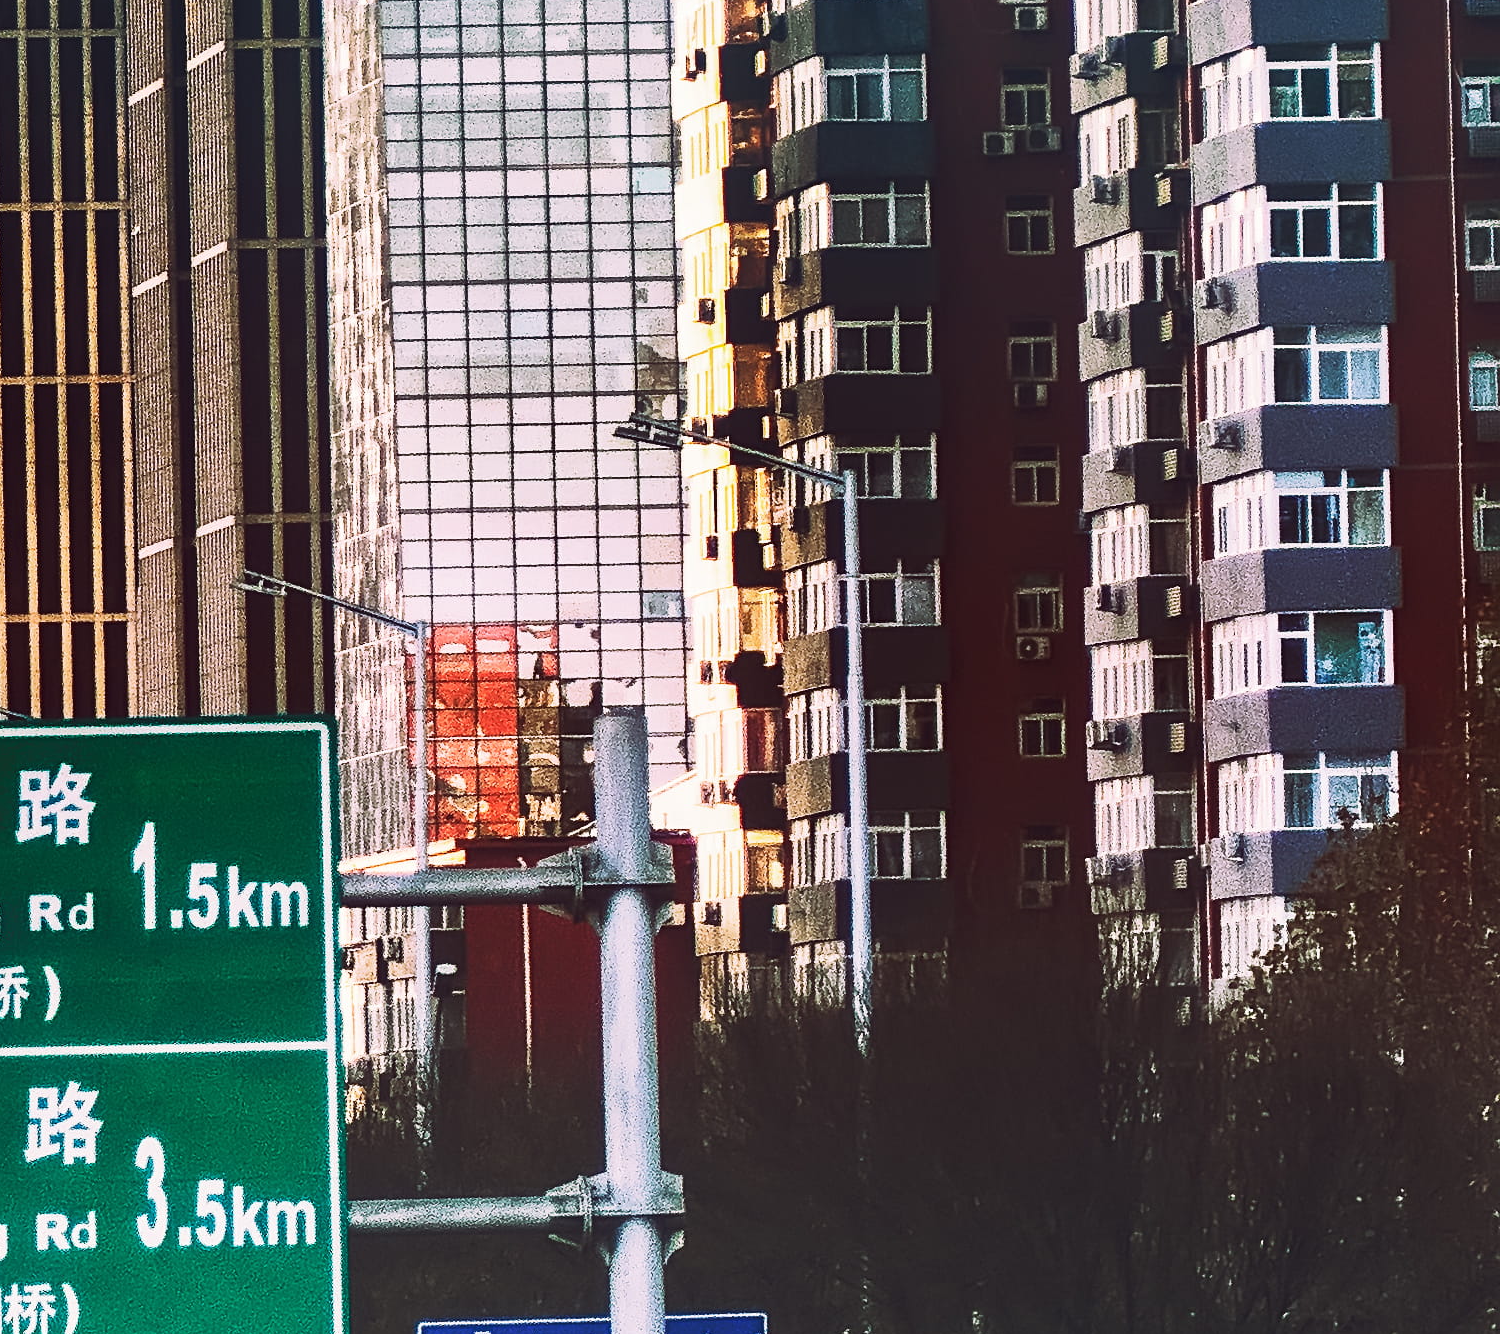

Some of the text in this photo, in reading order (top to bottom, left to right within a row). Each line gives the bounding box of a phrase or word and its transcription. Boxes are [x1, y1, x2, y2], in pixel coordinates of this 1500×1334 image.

[28, 892, 96, 933] Rd
[132, 821, 311, 931] 1.5km
[134, 1134, 318, 1249] 3.5km
[35, 1210, 98, 1251] Rd
